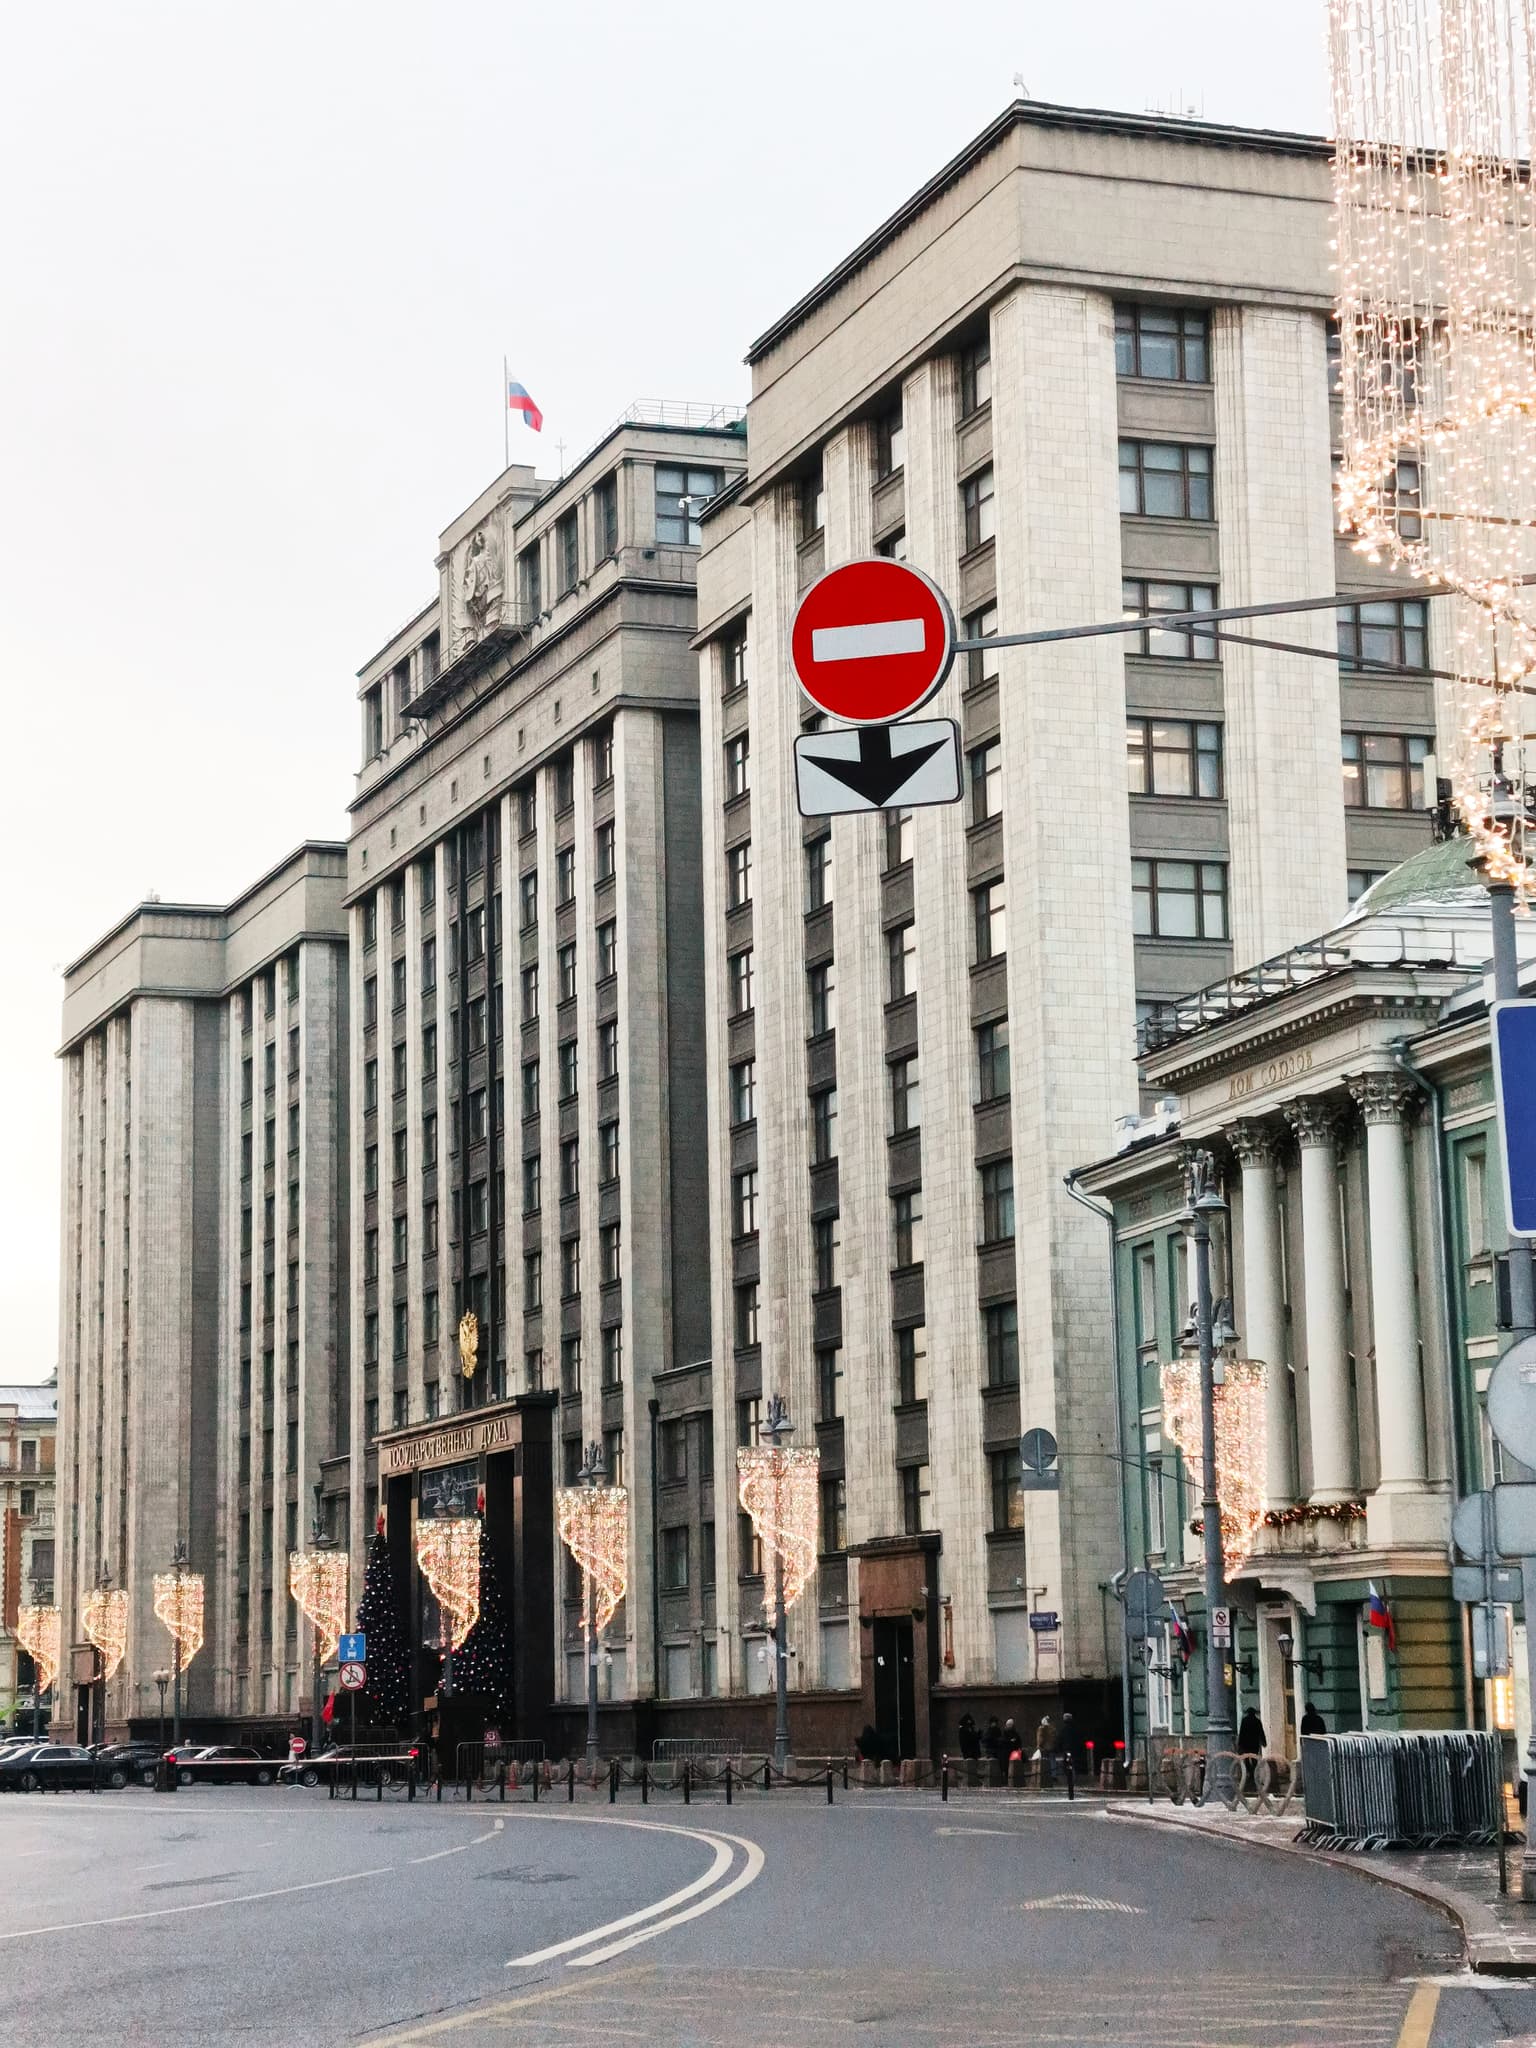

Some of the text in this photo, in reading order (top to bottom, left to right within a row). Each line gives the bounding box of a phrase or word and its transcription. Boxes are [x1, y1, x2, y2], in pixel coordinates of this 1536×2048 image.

[1229, 1050, 1312, 1100] ДОМ СОЮЗОВ
[388, 1419, 509, 1467] ГОСУДАРСТВЕННАЯ ДУМА
